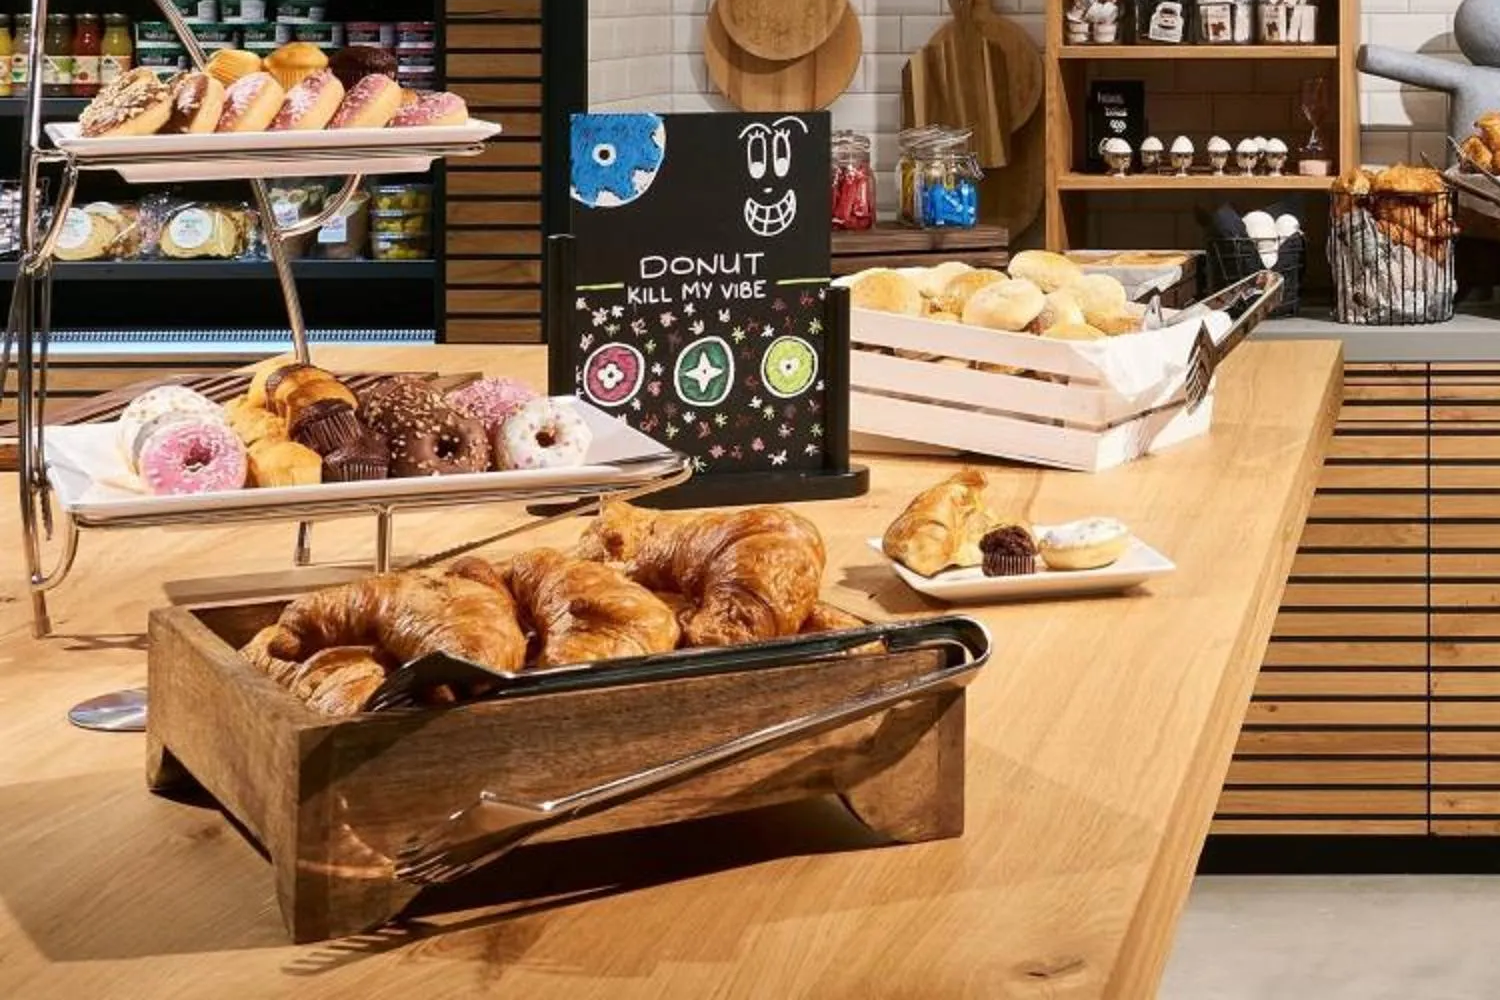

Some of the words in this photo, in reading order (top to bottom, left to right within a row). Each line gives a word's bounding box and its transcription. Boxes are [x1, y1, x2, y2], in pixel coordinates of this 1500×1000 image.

[639, 252, 765, 280] DONUT
[626, 285, 673, 305] KILL
[681, 280, 713, 301] MY
[720, 279, 767, 300] VIBE
